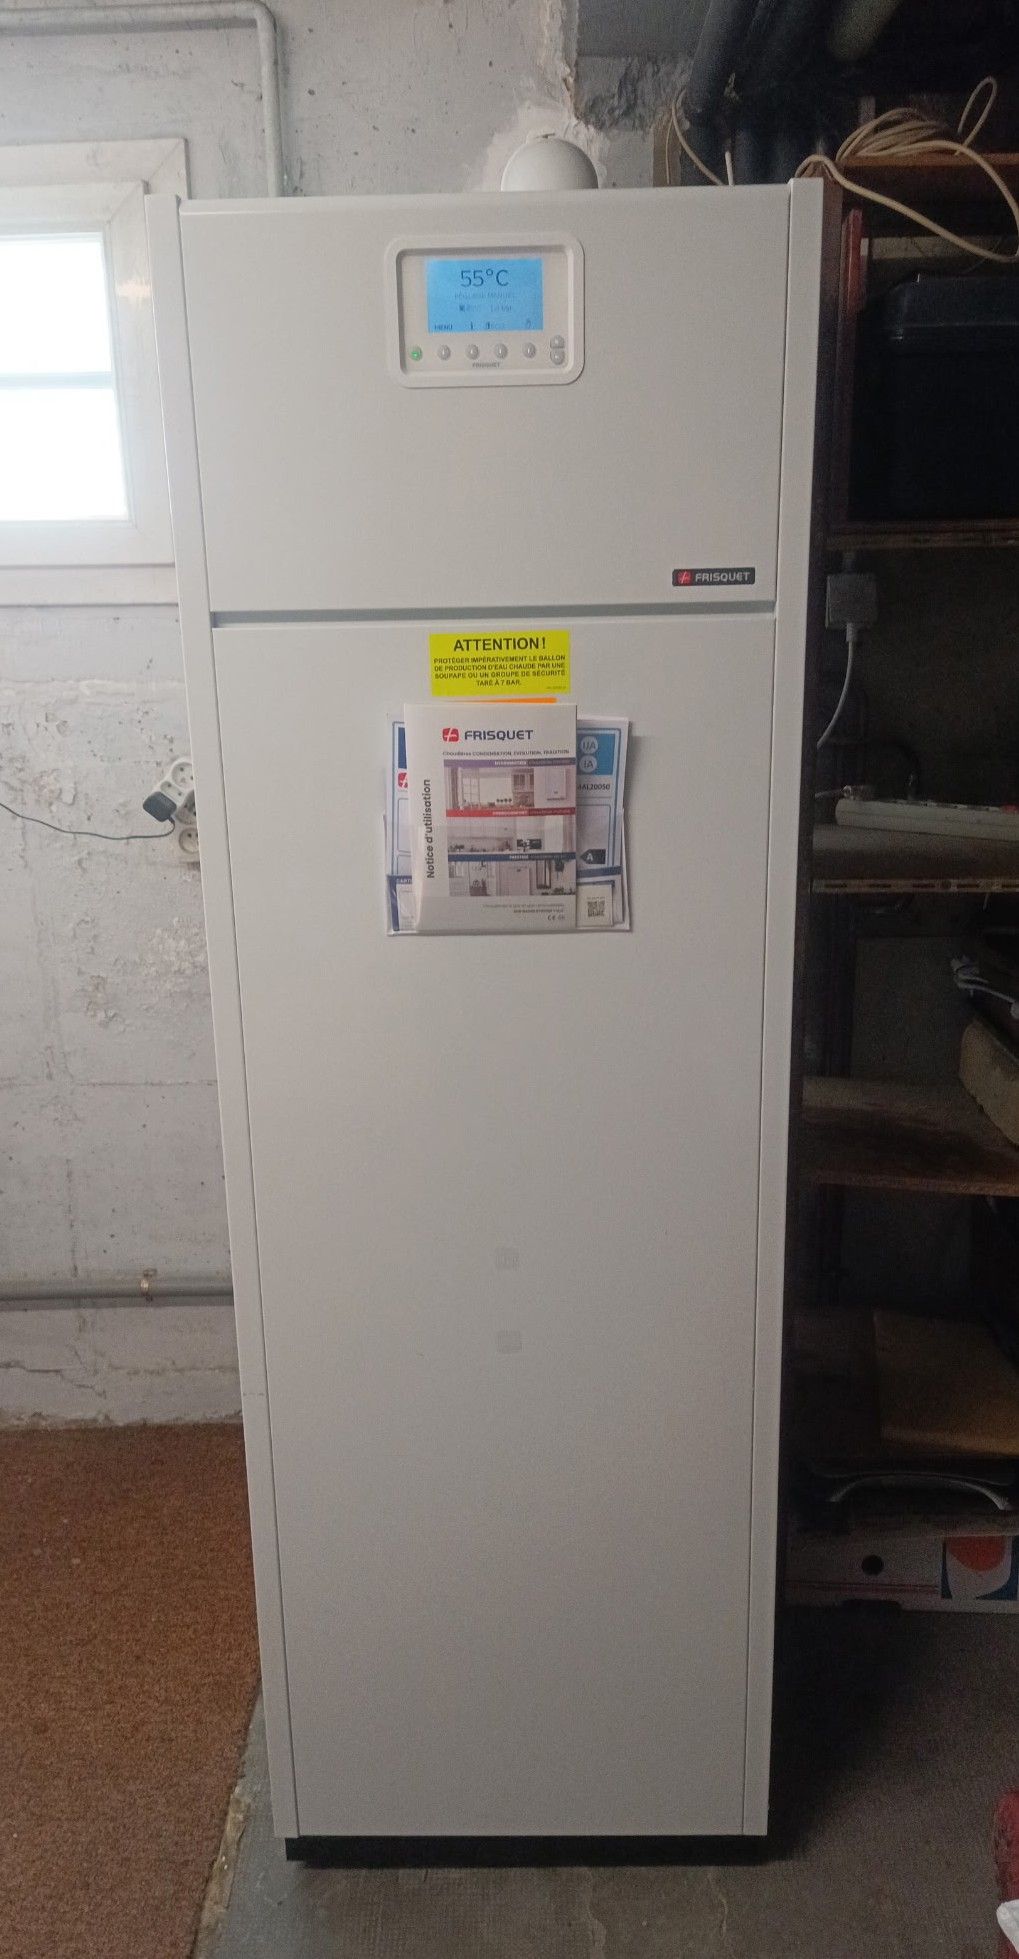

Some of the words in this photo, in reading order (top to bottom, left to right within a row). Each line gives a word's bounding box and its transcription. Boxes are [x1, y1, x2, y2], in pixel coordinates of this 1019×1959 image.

[460, 268, 509, 287] 55°C
[695, 572, 750, 582] FRISQUET
[453, 637, 539, 652] ATTENTION
[464, 730, 534, 741] FRISQUET
[422, 779, 433, 844] d'utilisation
[426, 845, 435, 879] Notice
[586, 853, 594, 861] A
